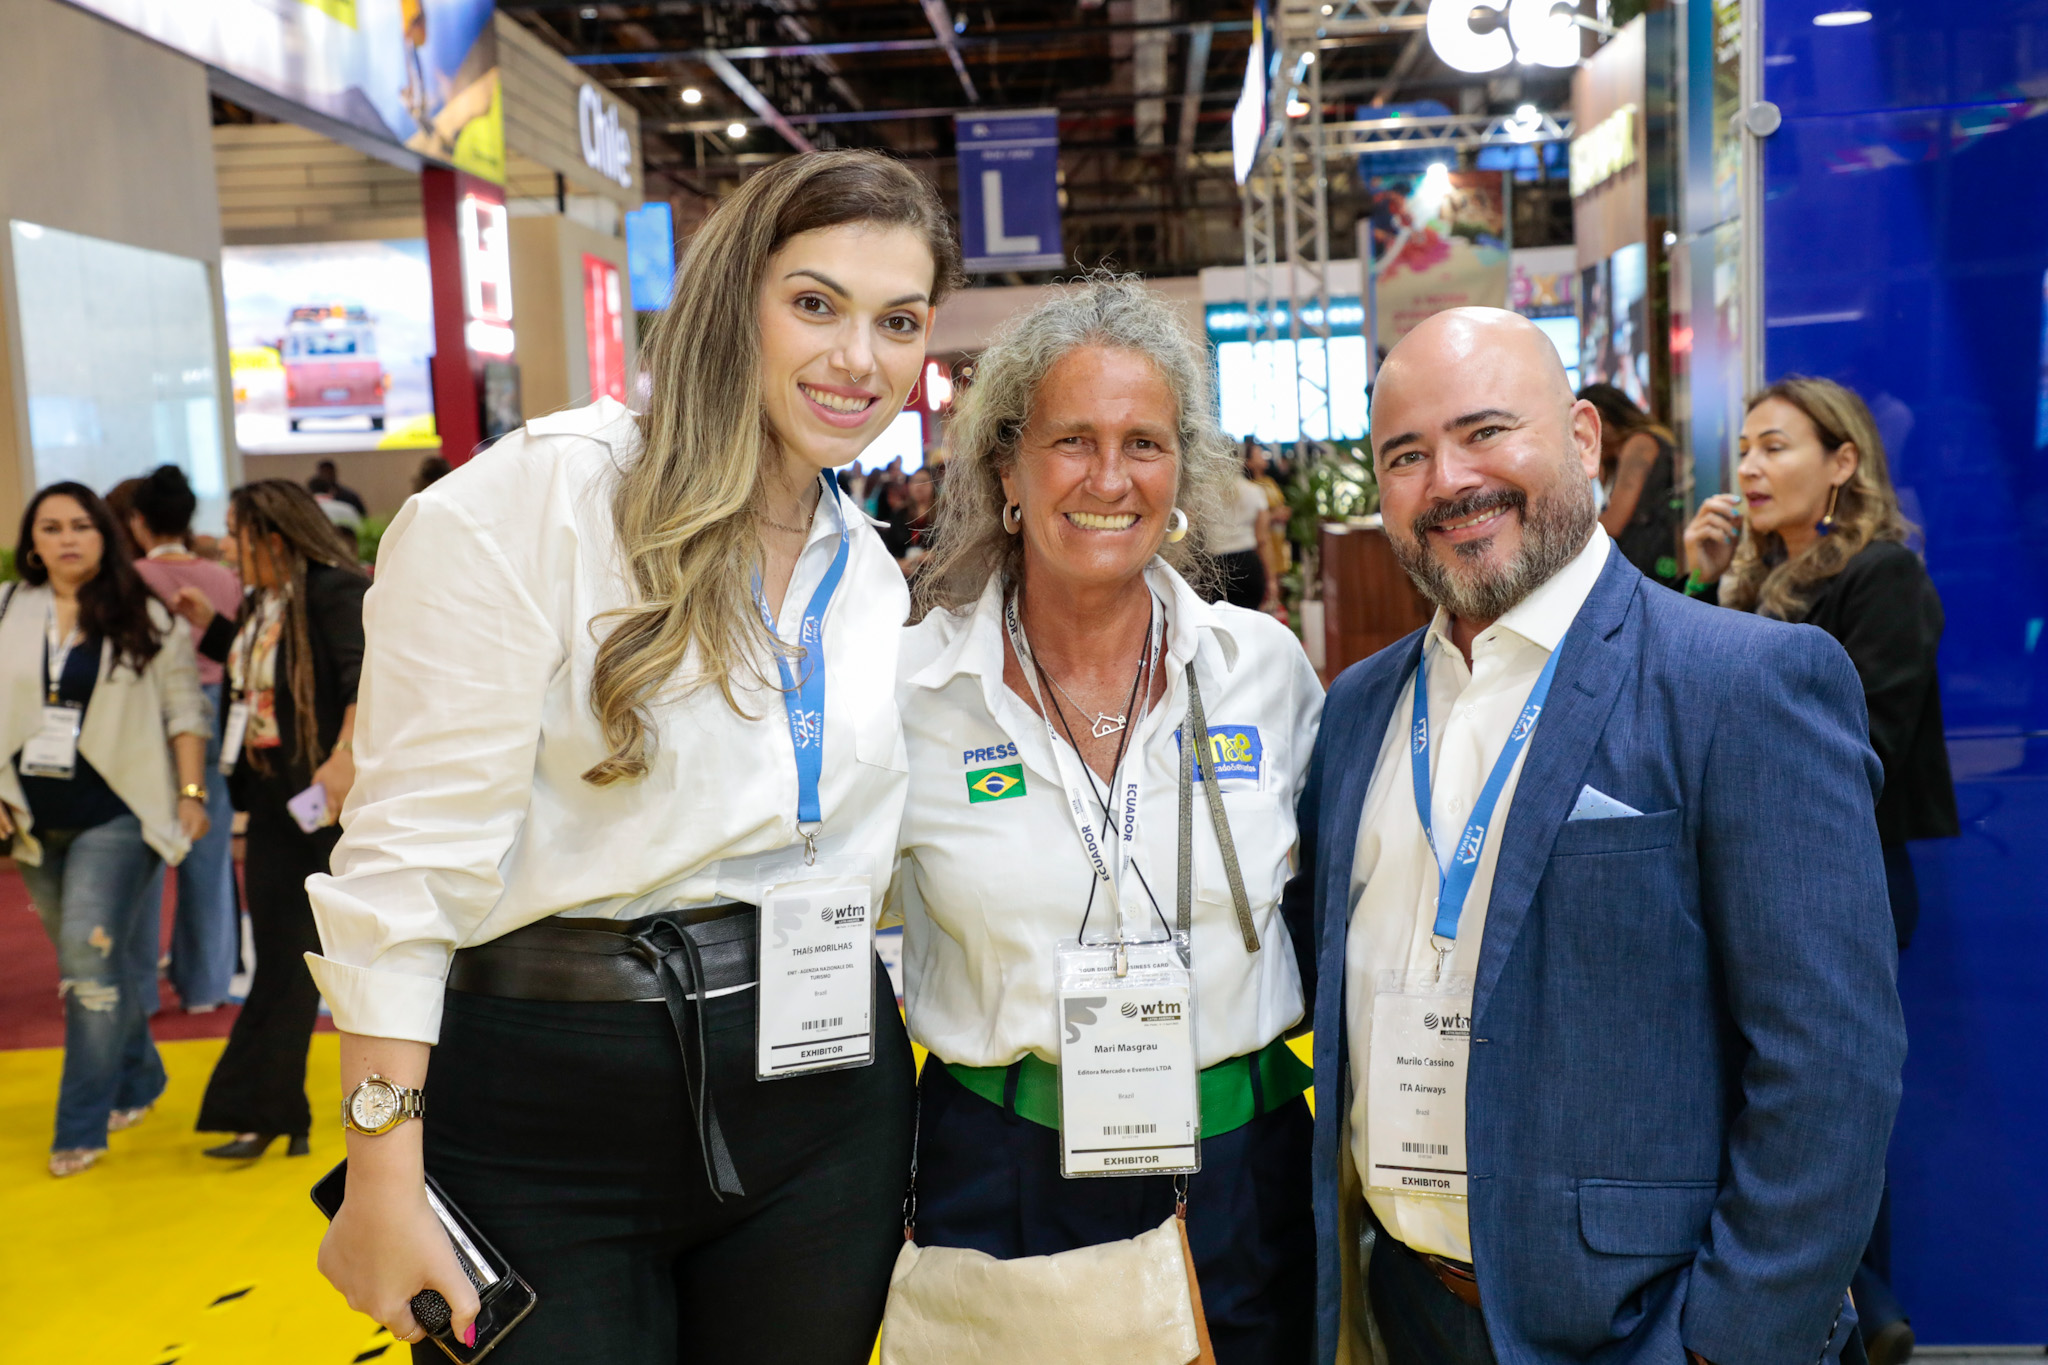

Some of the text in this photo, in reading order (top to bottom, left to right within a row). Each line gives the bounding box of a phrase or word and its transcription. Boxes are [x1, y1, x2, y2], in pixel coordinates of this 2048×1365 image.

[578, 83, 632, 188] Chile
[982, 169, 1041, 255] L
[803, 616, 815, 643] ITA
[791, 712, 801, 748] AIRWAYS
[814, 712, 822, 748] AIRWAYS
[1511, 705, 1531, 739] AIRWAYS
[1515, 704, 1542, 742] ITA
[1418, 717, 1428, 754] ITA
[963, 742, 1018, 765] PRESS
[1123, 783, 1138, 842] ECUADOR
[1082, 824, 1110, 882] ECUADOR
[1456, 825, 1474, 862] AIRWAYS
[1463, 825, 1485, 865] ITA
[835, 904, 865, 919] wtm
[792, 941, 853, 956] THAÍS MORILHAS
[1140, 1000, 1182, 1015] wtm
[800, 1045, 843, 1059] EXHIBITOR
[1094, 1043, 1158, 1054] Mari Masgrau
[1077, 1068, 1099, 1076] Editora
[1100, 1067, 1127, 1075] Mercado
[1131, 1066, 1155, 1074] Eventos
[1155, 1065, 1172, 1073] LTDA
[1396, 1056, 1454, 1068] Murilo Cassino
[1118, 1092, 1135, 1100] Brazil
[1399, 1083, 1447, 1095] ITA Airways
[1103, 1155, 1160, 1166] EXHIBITOR
[1401, 1176, 1451, 1189] EXHIBITOR
